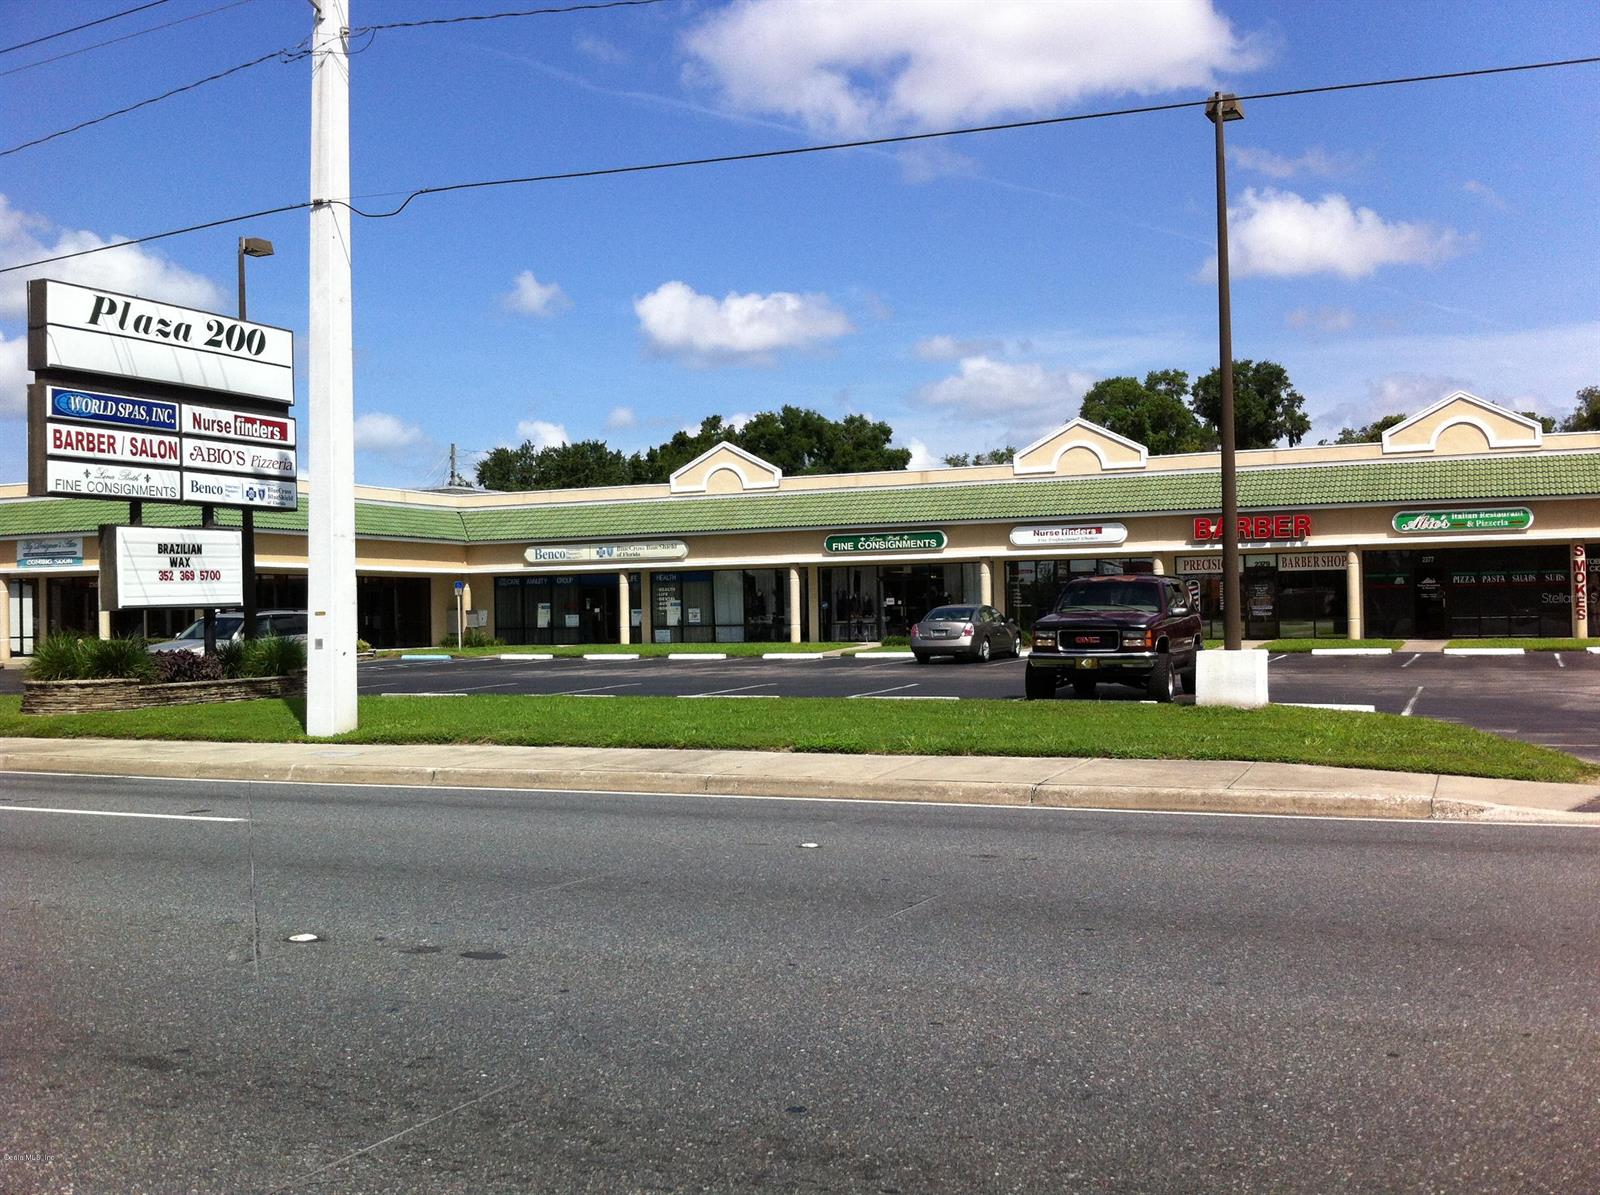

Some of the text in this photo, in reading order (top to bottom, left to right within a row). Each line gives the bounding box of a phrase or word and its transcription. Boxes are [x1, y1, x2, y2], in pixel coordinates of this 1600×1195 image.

[88, 294, 266, 356] Plaza 200
[69, 395, 175, 424] WORLD SPAS, INC.
[192, 412, 232, 434] Nurse
[53, 428, 117, 455] BARBER
[130, 437, 178, 460] SALON
[189, 445, 293, 471] ABIO'S Pizzeria
[55, 478, 177, 498] FINE CONSIGNMENTS
[190, 480, 223, 495] Benco
[1401, 512, 1450, 530] Abio's
[1475, 519, 1509, 527] Pizzeria
[1033, 529, 1060, 537] Nurse
[157, 543, 202, 555] BRAZILIAN
[832, 539, 937, 551] FINE CONSIGNMENTS
[534, 549, 566, 560] Benco
[26, 558, 52, 566] COMING
[169, 557, 191, 568] WAX
[1183, 560, 1223, 571] PRECISI
[1281, 556, 1347, 568] BARBER SHOP
[158, 570, 221, 581] 352 369 5700
[1453, 575, 1476, 584] PIZZA
[1482, 574, 1506, 583] PASTA
[1573, 545, 1586, 620] SMOKES
